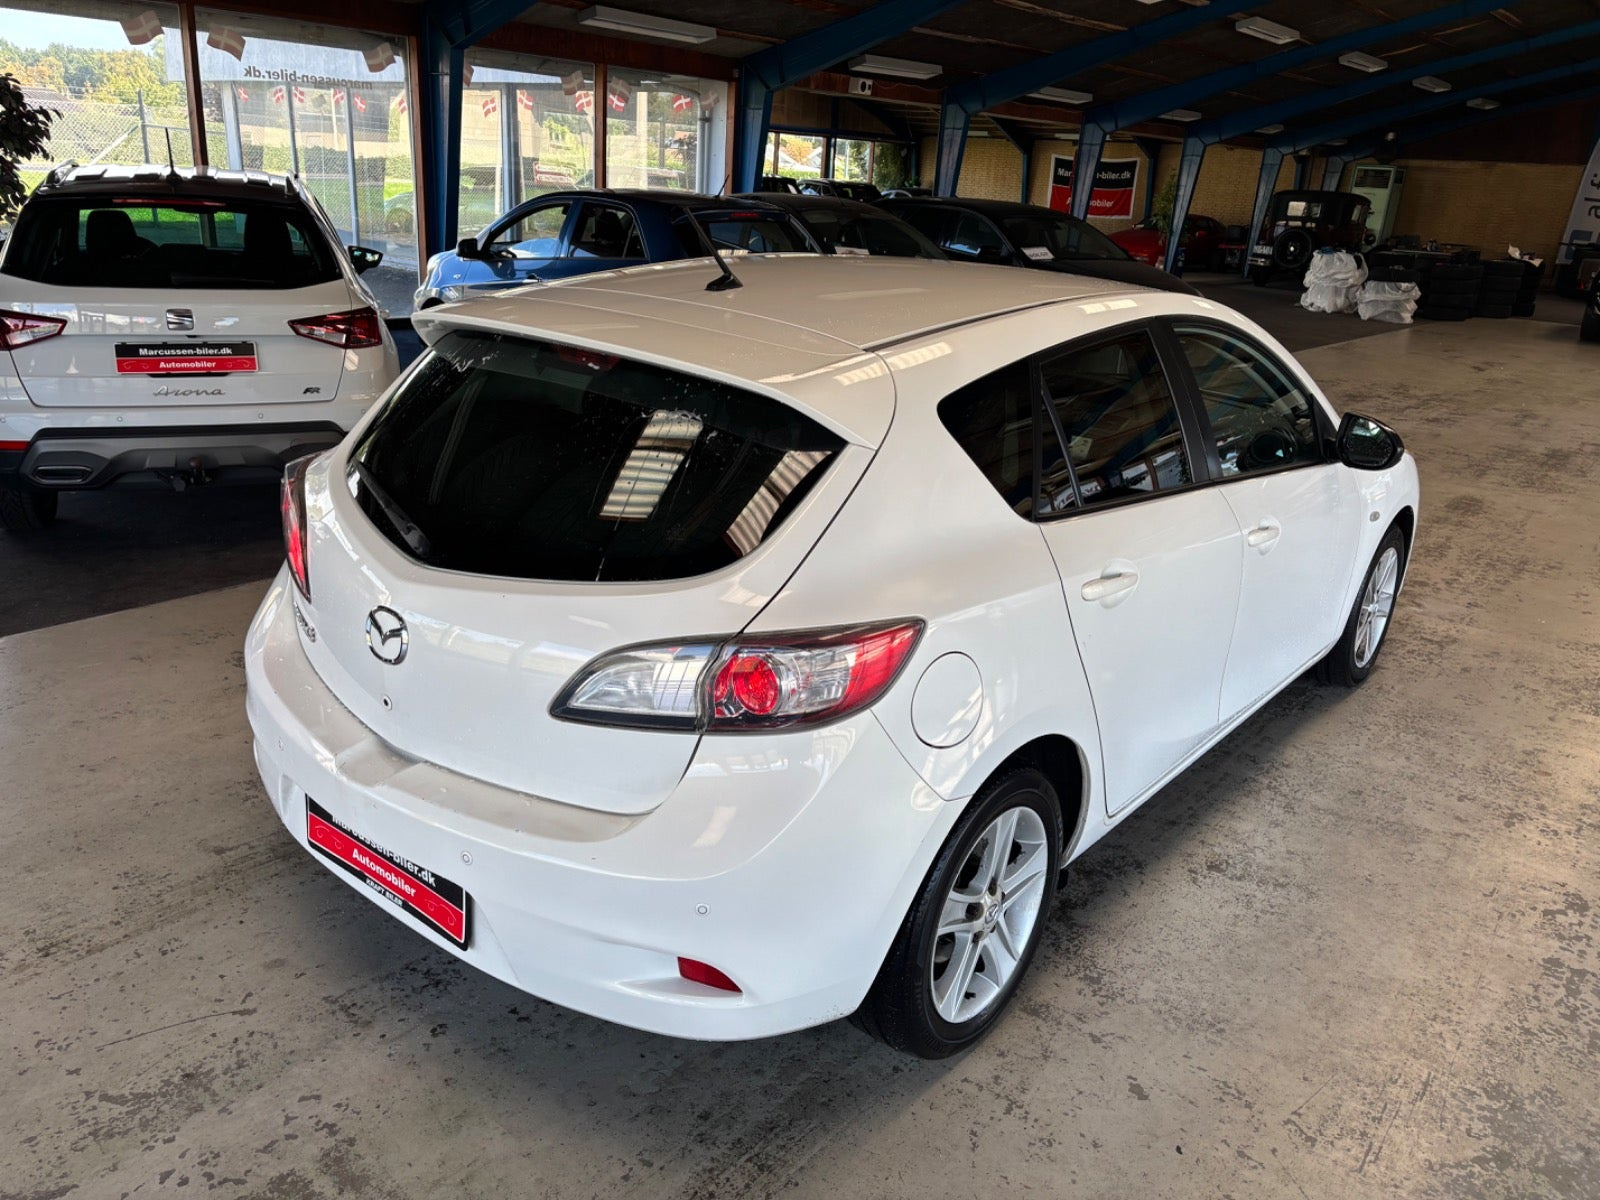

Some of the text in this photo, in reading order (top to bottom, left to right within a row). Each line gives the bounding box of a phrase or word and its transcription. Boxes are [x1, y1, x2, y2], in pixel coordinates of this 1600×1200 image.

[1057, 168, 1131, 180] Mar-biler.dk
[1066, 196, 1114, 207] Aobiler
[139, 347, 233, 356] Marcussen-biler.dk
[159, 361, 216, 369] Automobiler
[153, 385, 225, 397] Arona
[303, 386, 321, 395] FR
[352, 848, 417, 898] Automobiler
